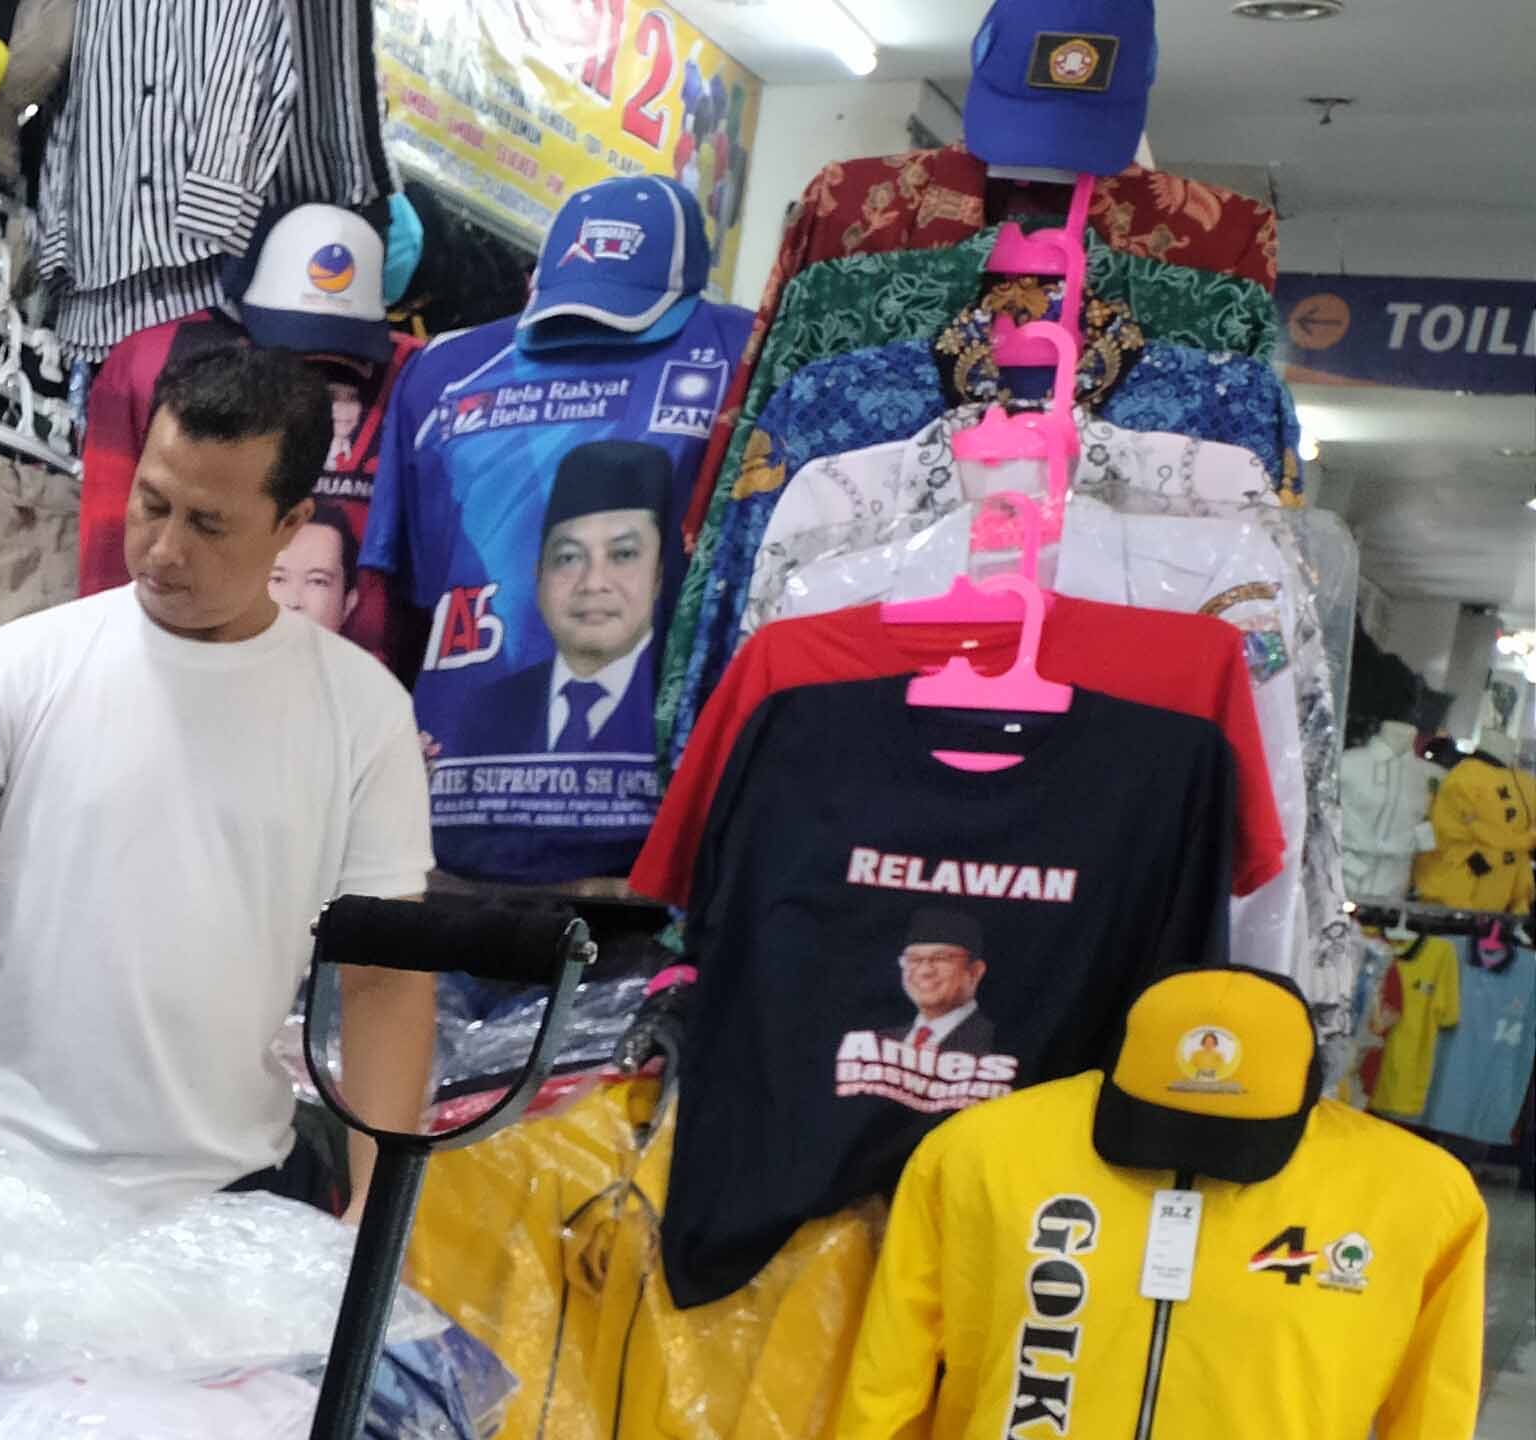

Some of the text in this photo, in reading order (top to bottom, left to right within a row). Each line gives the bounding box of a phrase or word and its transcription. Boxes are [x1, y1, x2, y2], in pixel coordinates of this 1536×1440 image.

[1385, 302, 1536, 357] TOIL
[495, 378, 630, 406] Bela Rakyat
[489, 399, 608, 428] Bela Umat
[656, 407, 714, 431] PAN
[312, 476, 374, 497] JUAN
[846, 846, 1078, 903] RELAWAN
[836, 1029, 1020, 1082] Anies
[1249, 1225, 1317, 1286] 4
